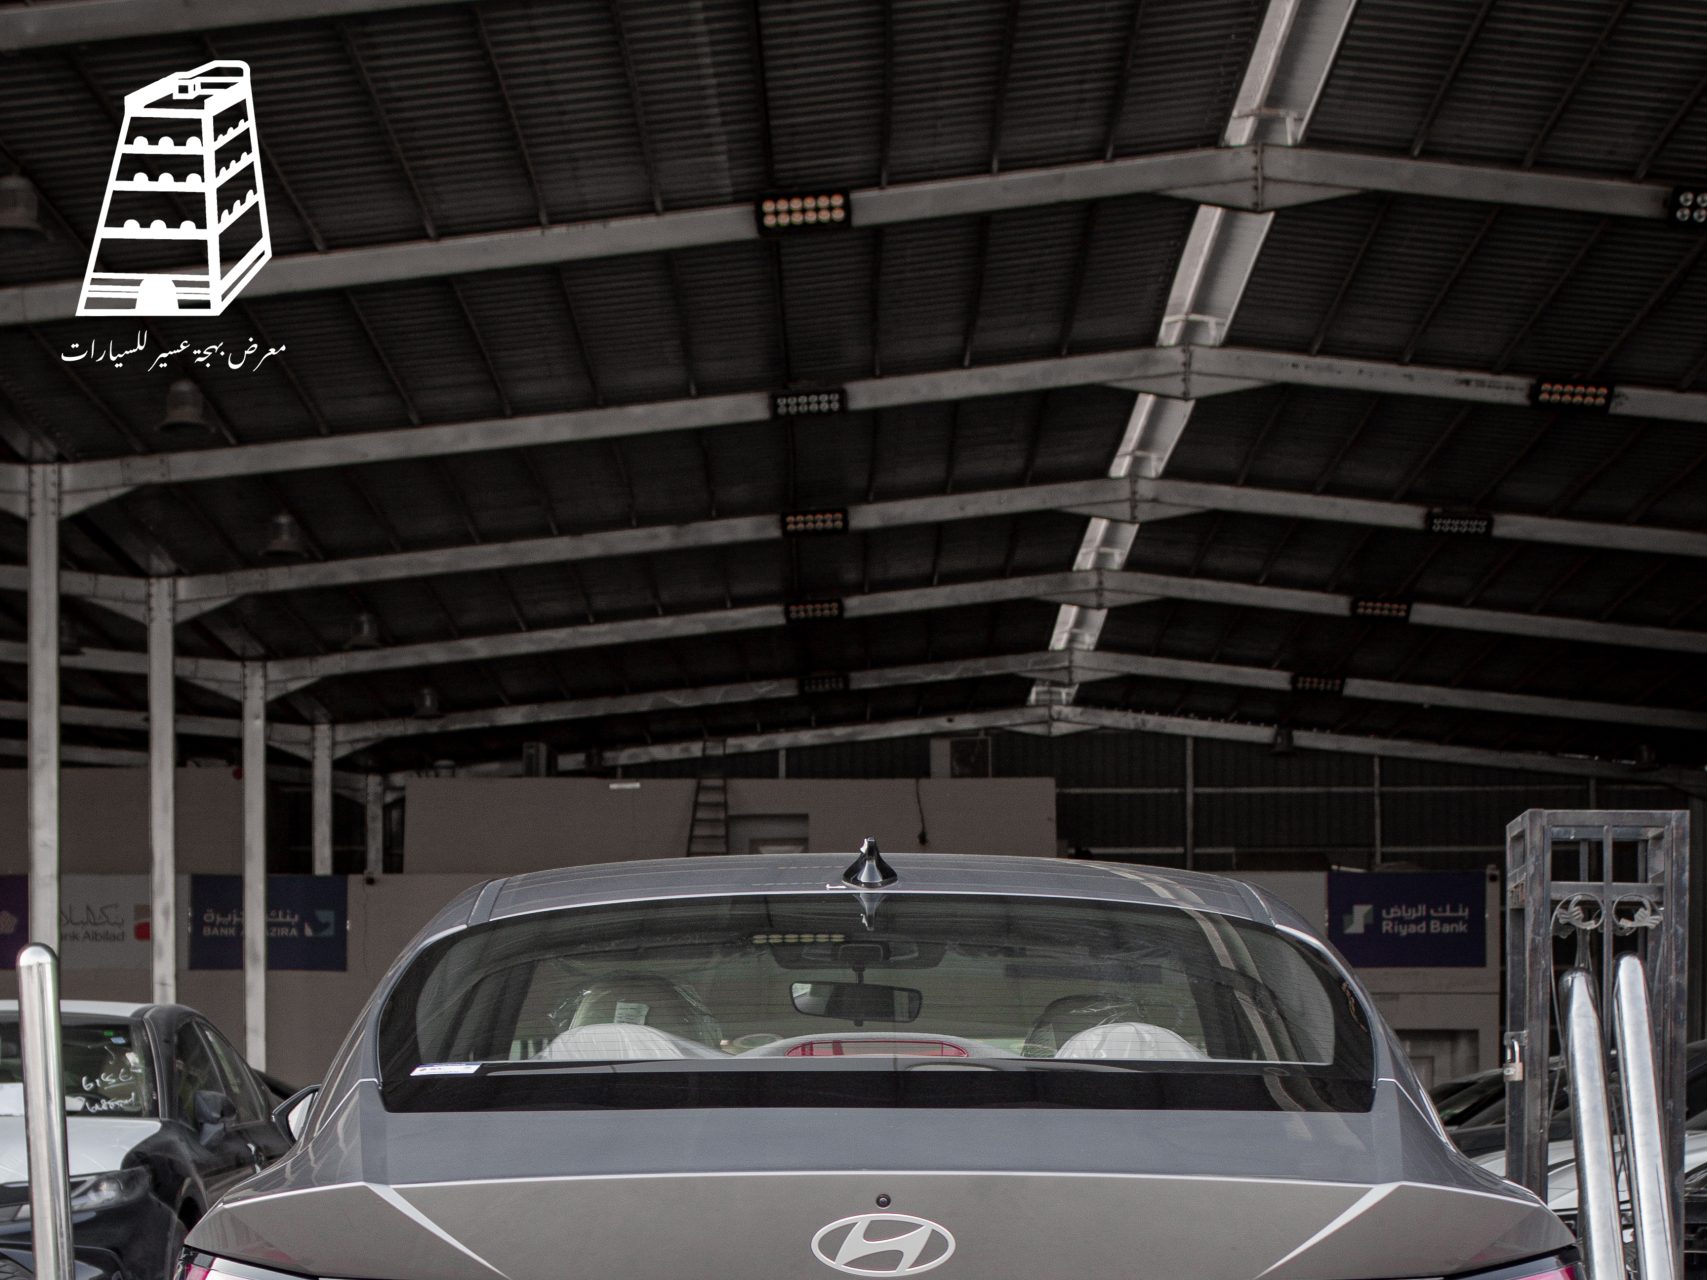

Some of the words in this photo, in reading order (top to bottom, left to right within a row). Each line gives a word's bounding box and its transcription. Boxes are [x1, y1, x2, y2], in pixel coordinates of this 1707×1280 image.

[1381, 904, 1427, 920] الرياض
[1429, 903, 1470, 919] بنك
[202, 926, 236, 938] BANK
[1381, 920, 1427, 937] Riyad
[1429, 919, 1469, 934] Bank
